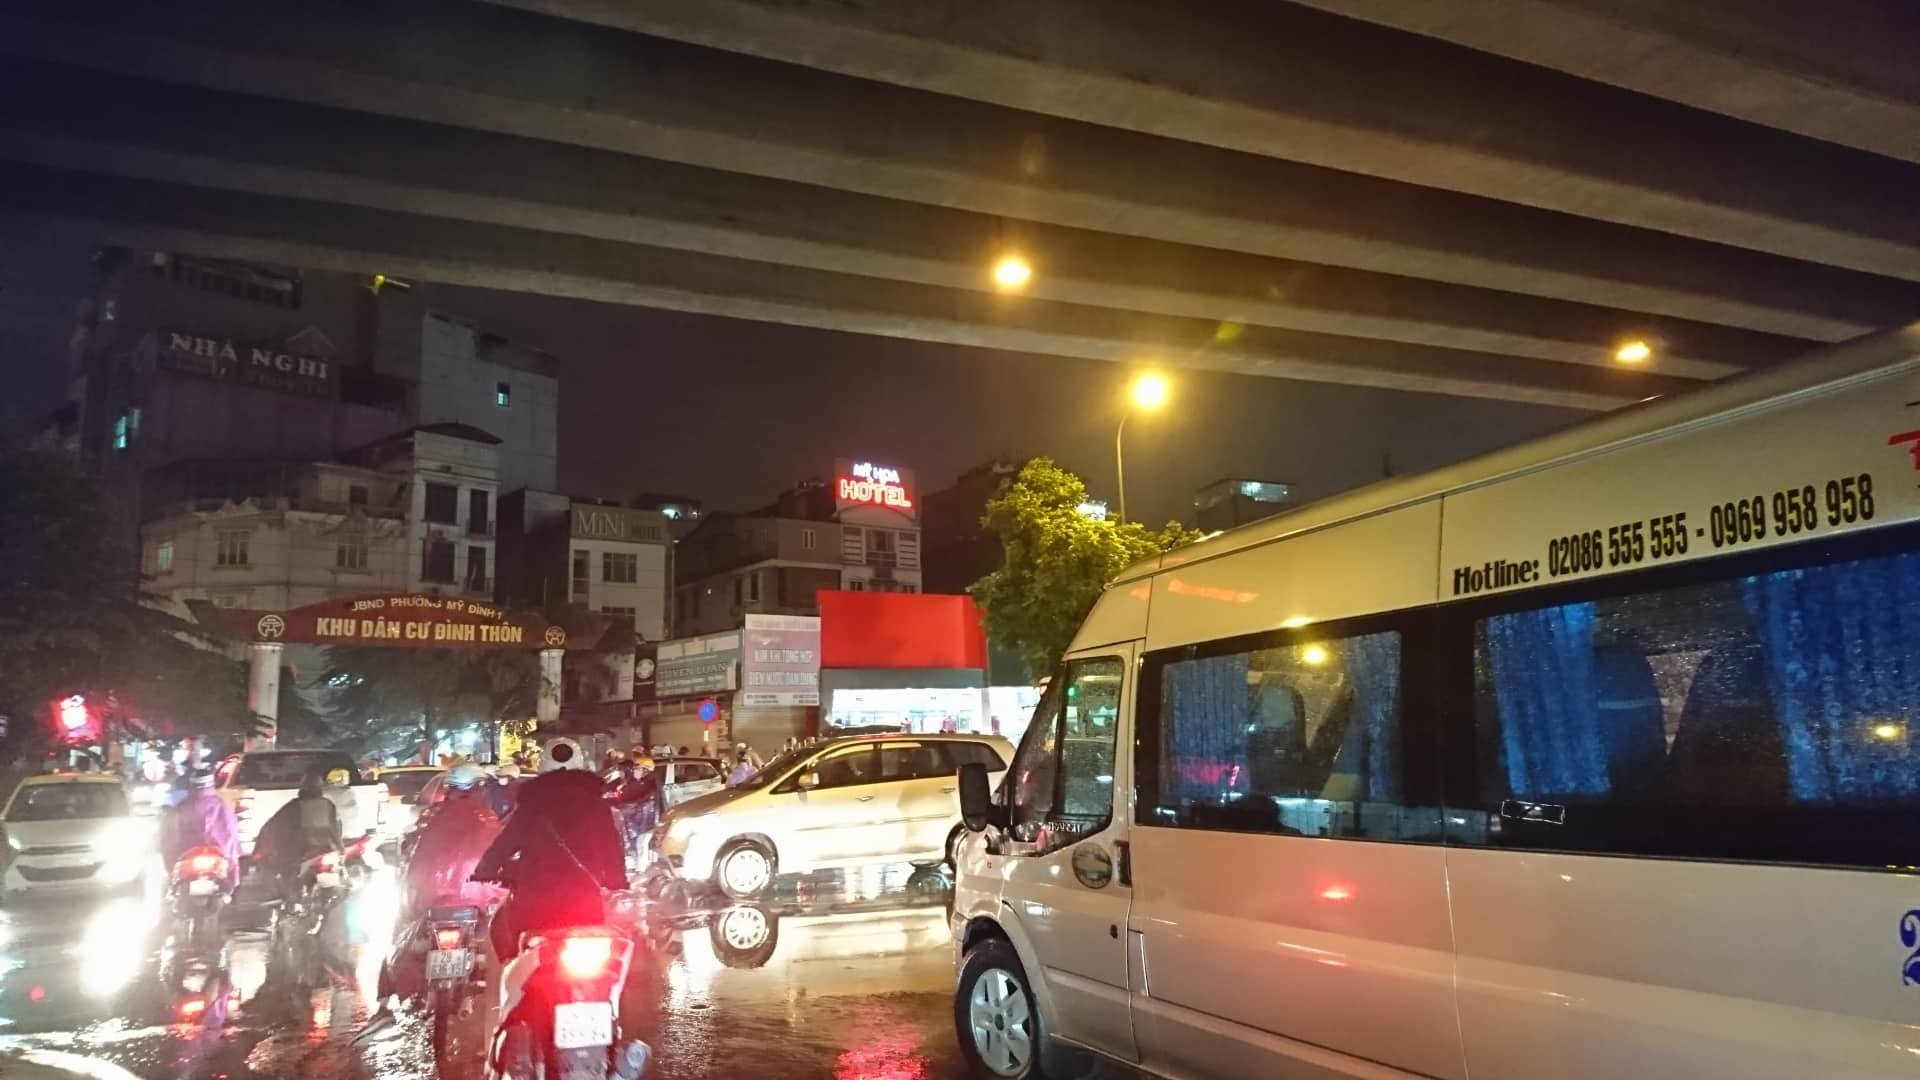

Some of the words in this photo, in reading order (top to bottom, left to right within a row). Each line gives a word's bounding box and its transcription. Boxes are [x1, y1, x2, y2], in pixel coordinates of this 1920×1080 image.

[841, 479, 912, 507] HOTEL
[1453, 558, 1540, 595] Hotline:
[1549, 529, 1603, 577] 02086
[1609, 520, 1644, 566] 555
[1650, 512, 1689, 558] 555
[1710, 495, 1765, 548] 0969
[1773, 485, 1817, 537] 958
[1826, 473, 1875, 525] 958
[316, 617, 356, 637] KHU
[361, 615, 401, 639] DÂN
[405, 619, 433, 640] CƯ
[480, 621, 523, 643] THÔN
